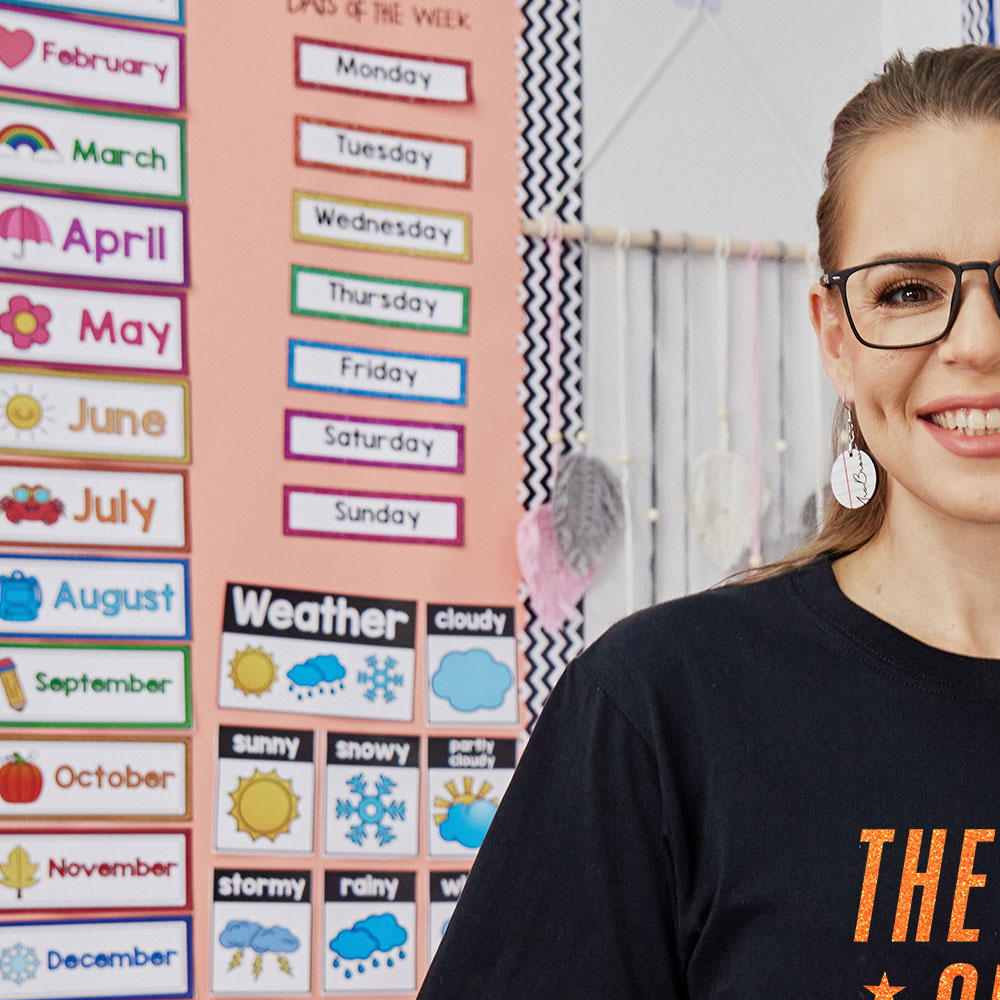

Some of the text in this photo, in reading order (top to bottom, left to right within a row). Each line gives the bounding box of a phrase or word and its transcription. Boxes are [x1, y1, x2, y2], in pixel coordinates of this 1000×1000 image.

[347, 0, 366, 23] OF
[375, 3, 402, 25] THE
[413, 7, 471, 30] WEEK
[43, 41, 168, 83] February
[336, 55, 432, 91] Monday
[73, 138, 166, 171] March
[337, 134, 433, 170] Tuesday
[62, 218, 166, 262] April
[315, 206, 453, 246] Wednesday
[329, 282, 438, 317] Thursday
[79, 308, 171, 354] May
[340, 357, 418, 387] Friday
[69, 397, 167, 436] June
[324, 425, 435, 457] Saturday
[74, 488, 156, 533] July
[335, 501, 421, 530] Sunday
[54, 580, 175, 617] August
[233, 586, 410, 642] Weather
[434, 607, 508, 634] cloudy
[36, 672, 173, 696] September
[232, 731, 301, 760] sunny
[335, 737, 411, 763] snowy
[448, 737, 496, 755] partly
[54, 765, 175, 790] October
[448, 754, 497, 770] cloudy
[48, 857, 179, 880] November
[217, 872, 306, 899] stormy
[340, 872, 399, 899] rainy
[853, 828, 996, 942] THE
[47, 947, 177, 972] December
